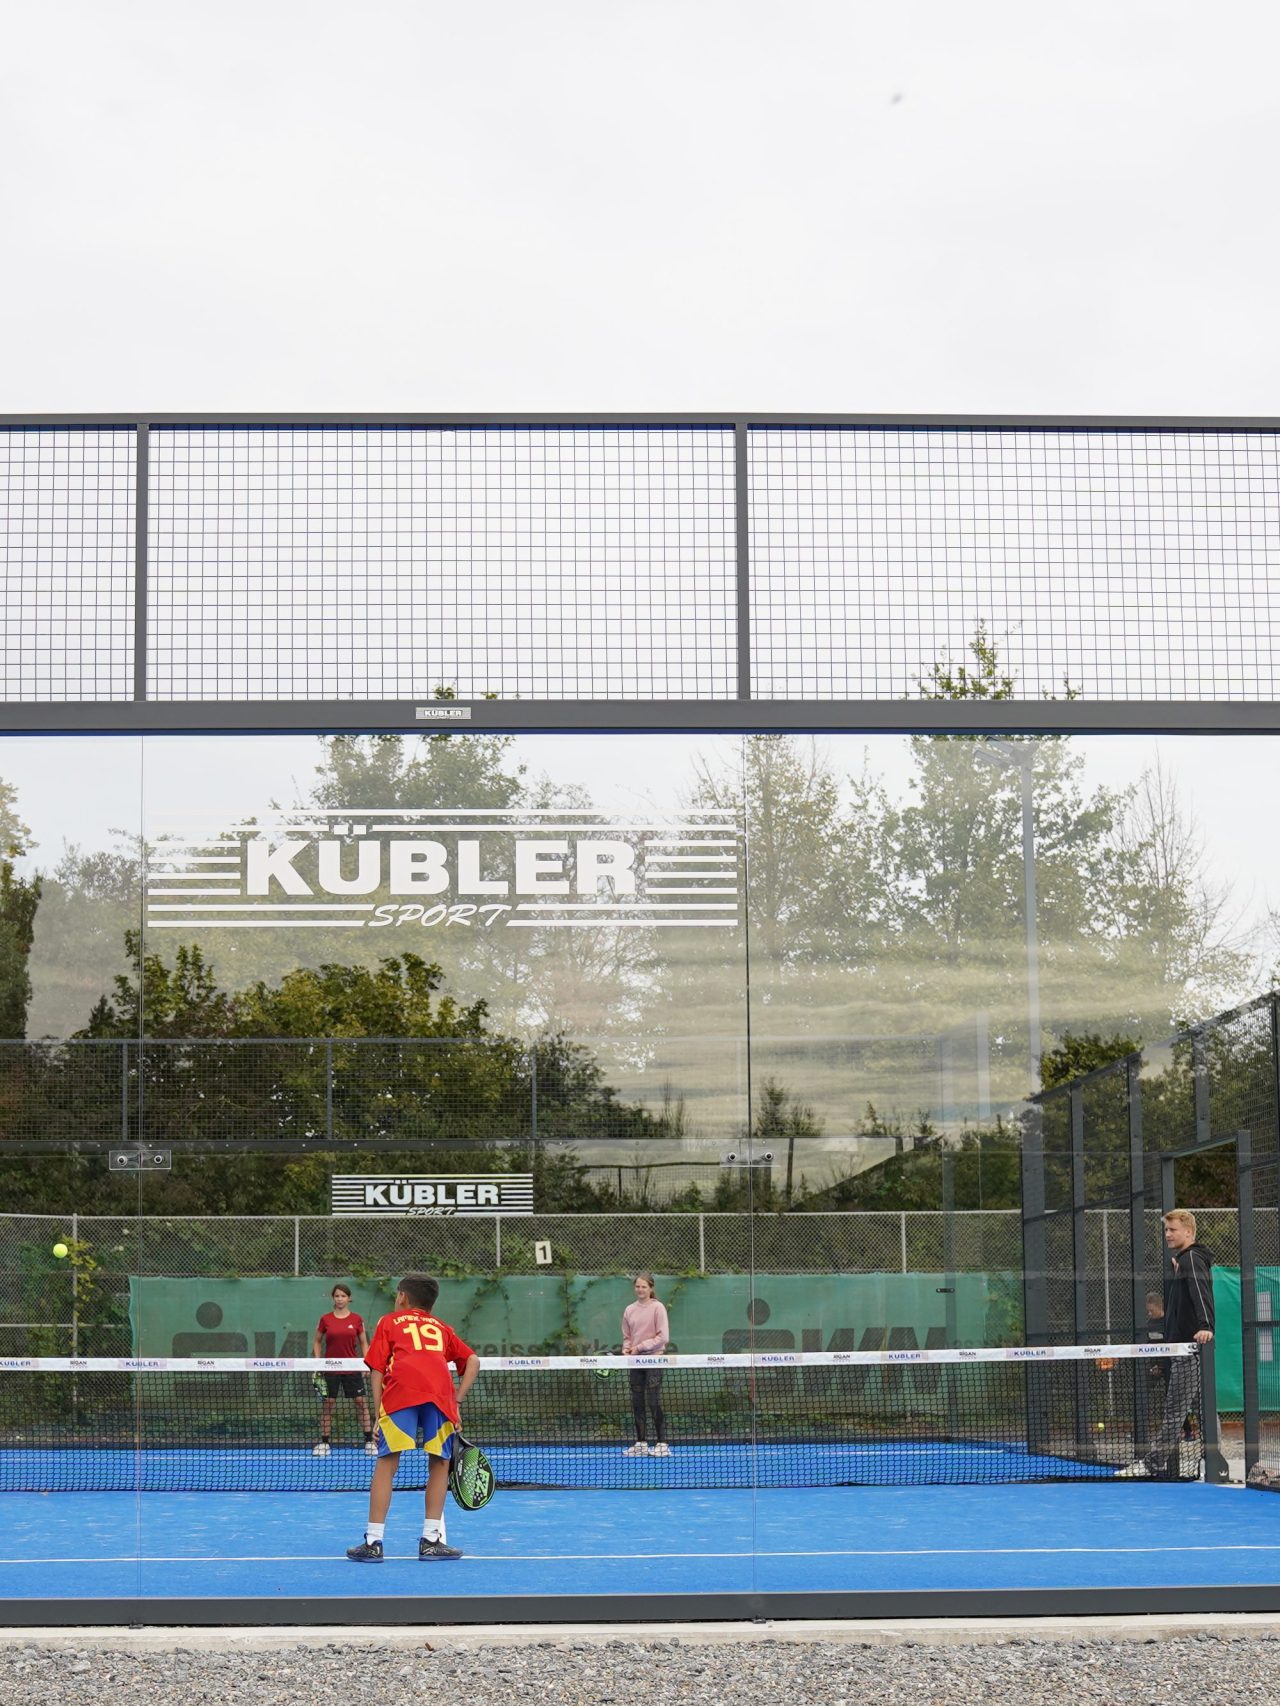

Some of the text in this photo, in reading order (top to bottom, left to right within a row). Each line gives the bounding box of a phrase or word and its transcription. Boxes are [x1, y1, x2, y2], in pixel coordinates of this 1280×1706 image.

[247, 824, 638, 895] KÜBLER
[368, 904, 512, 927] SPORT
[365, 1179, 499, 1205] KÜBLER
[408, 1207, 456, 1215] SPORT
[539, 1245, 547, 1260] 1
[403, 1323, 443, 1351] 19
